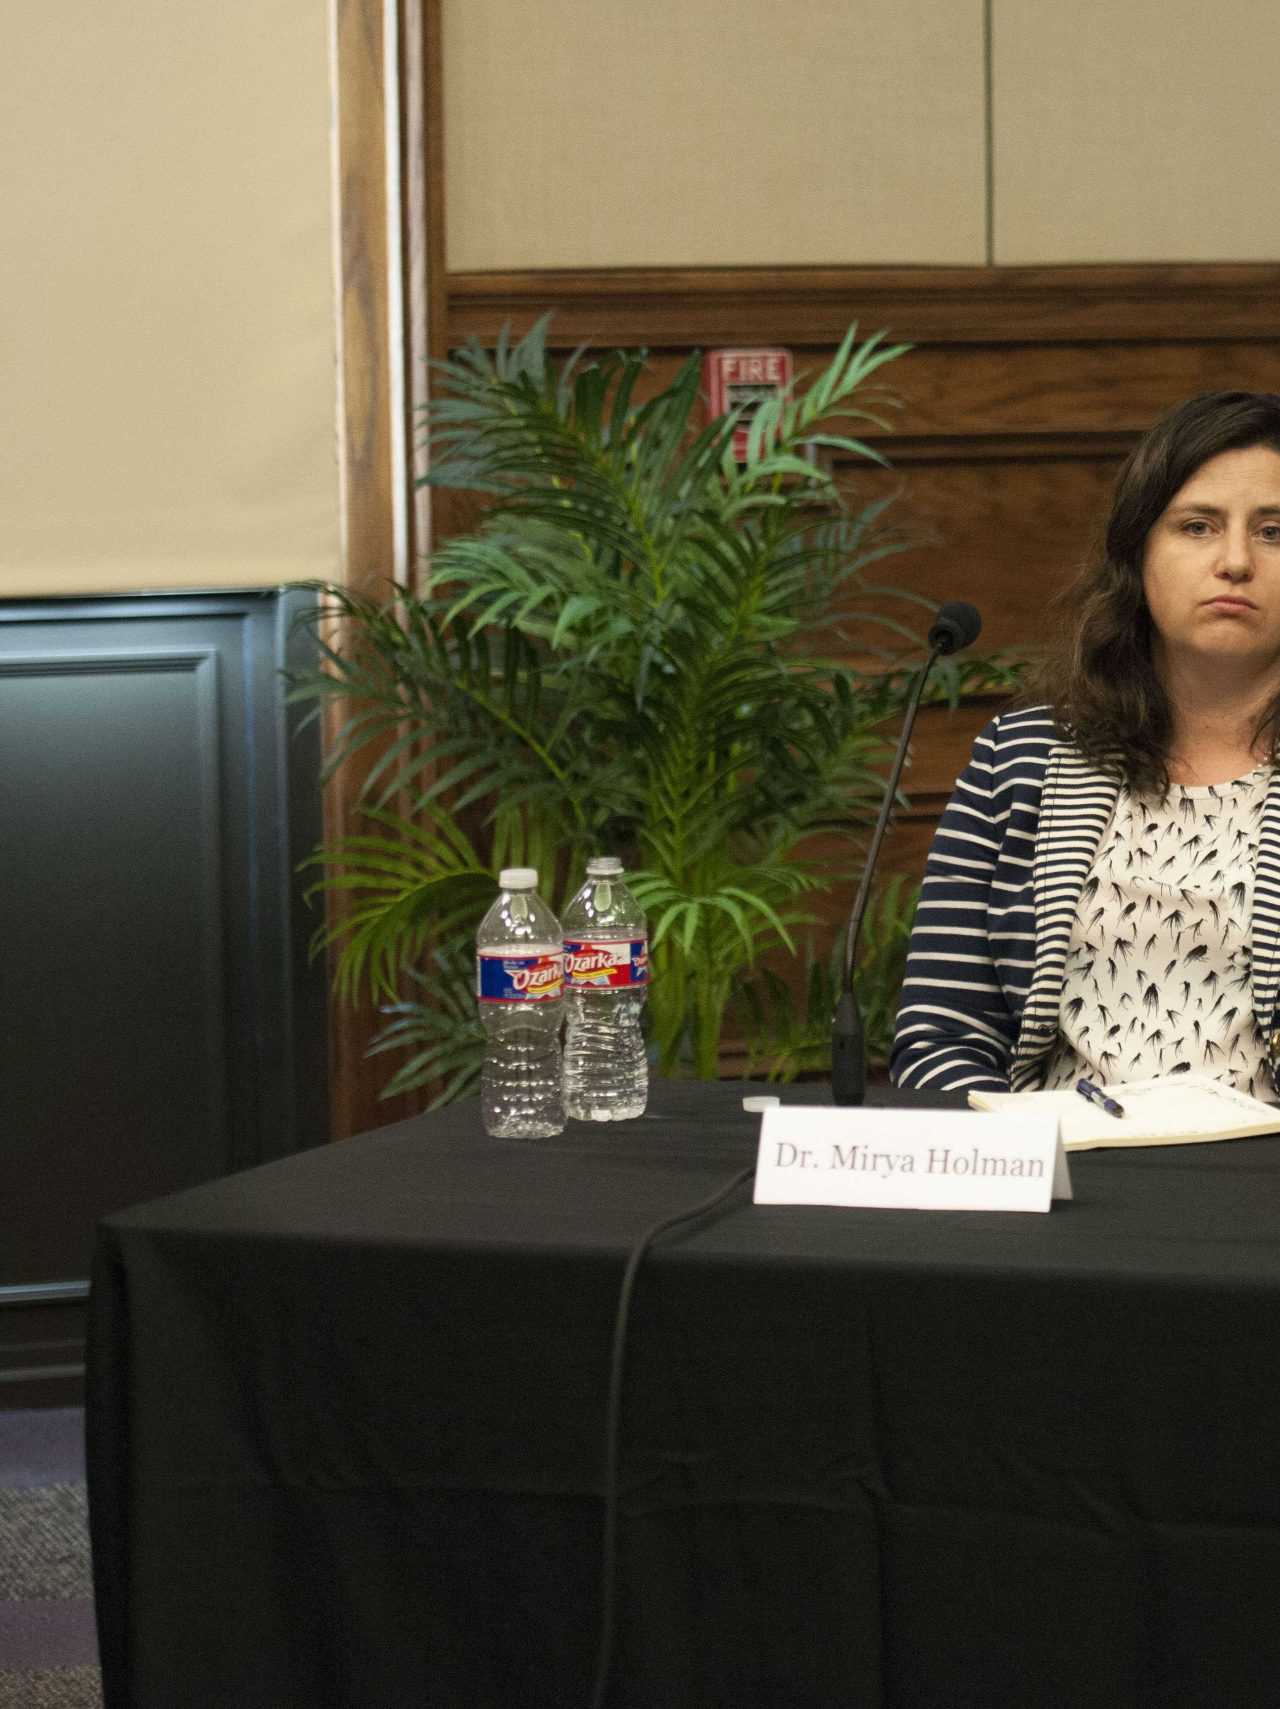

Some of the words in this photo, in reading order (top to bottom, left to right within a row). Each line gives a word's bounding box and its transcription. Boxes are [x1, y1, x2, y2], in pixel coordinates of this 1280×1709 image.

[722, 357, 780, 381] FIRE
[775, 1142, 819, 1169] Dr.
[831, 1144, 915, 1178] Mirya
[927, 1148, 1045, 1178] Holman
